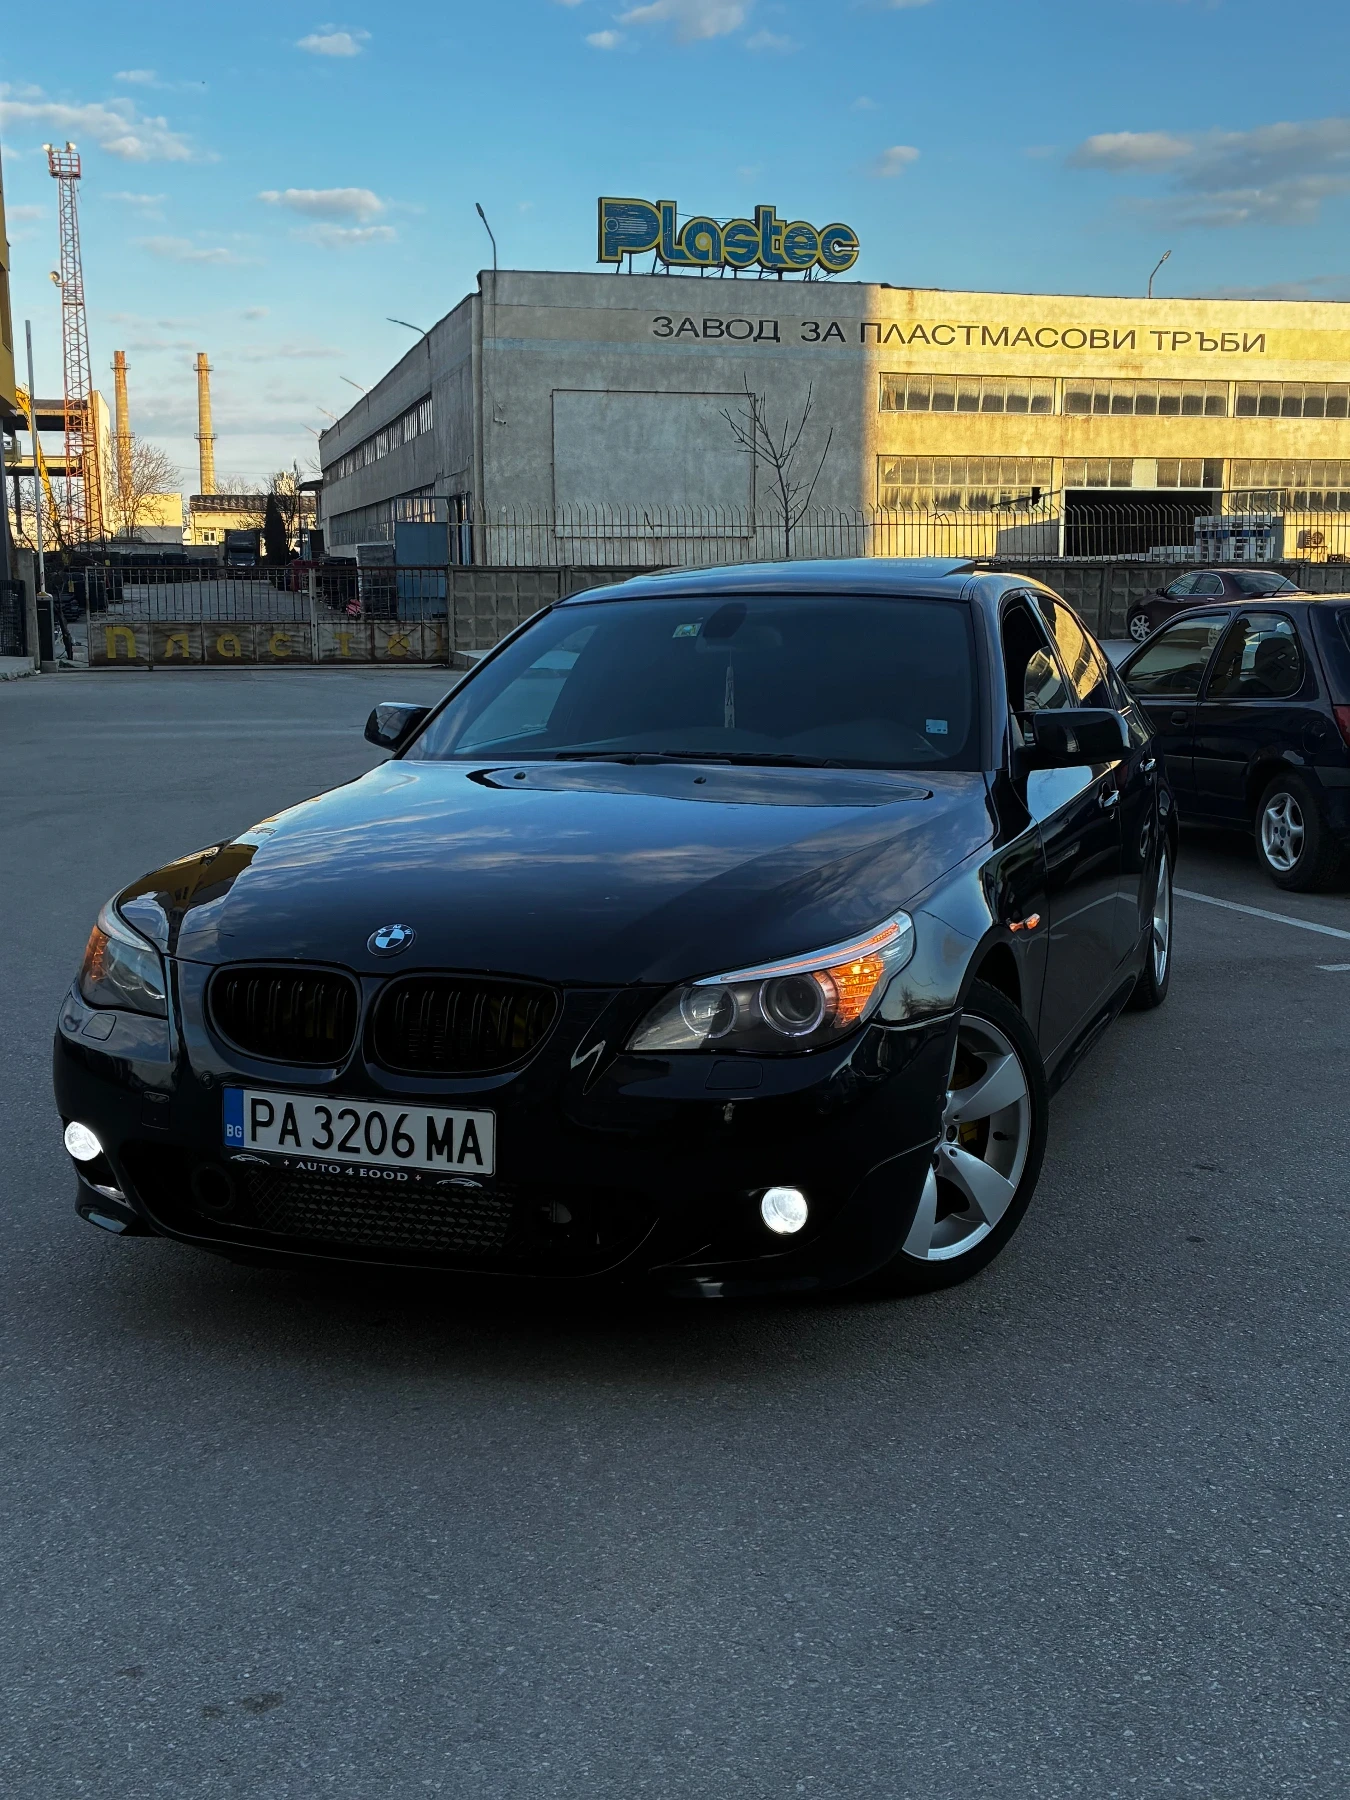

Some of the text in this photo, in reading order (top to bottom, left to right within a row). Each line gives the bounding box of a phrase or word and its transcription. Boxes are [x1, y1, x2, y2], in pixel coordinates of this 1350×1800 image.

[597, 197, 860, 273] Plastec
[652, 316, 1266, 353] ЗАВОД ЗА ПЛАСТМАСОВИ ТРЪБИ
[226, 1123, 242, 1138] BG
[250, 1098, 484, 1166] PA 3206 MA
[296, 1161, 408, 1181] AUTO 4 EOOD
